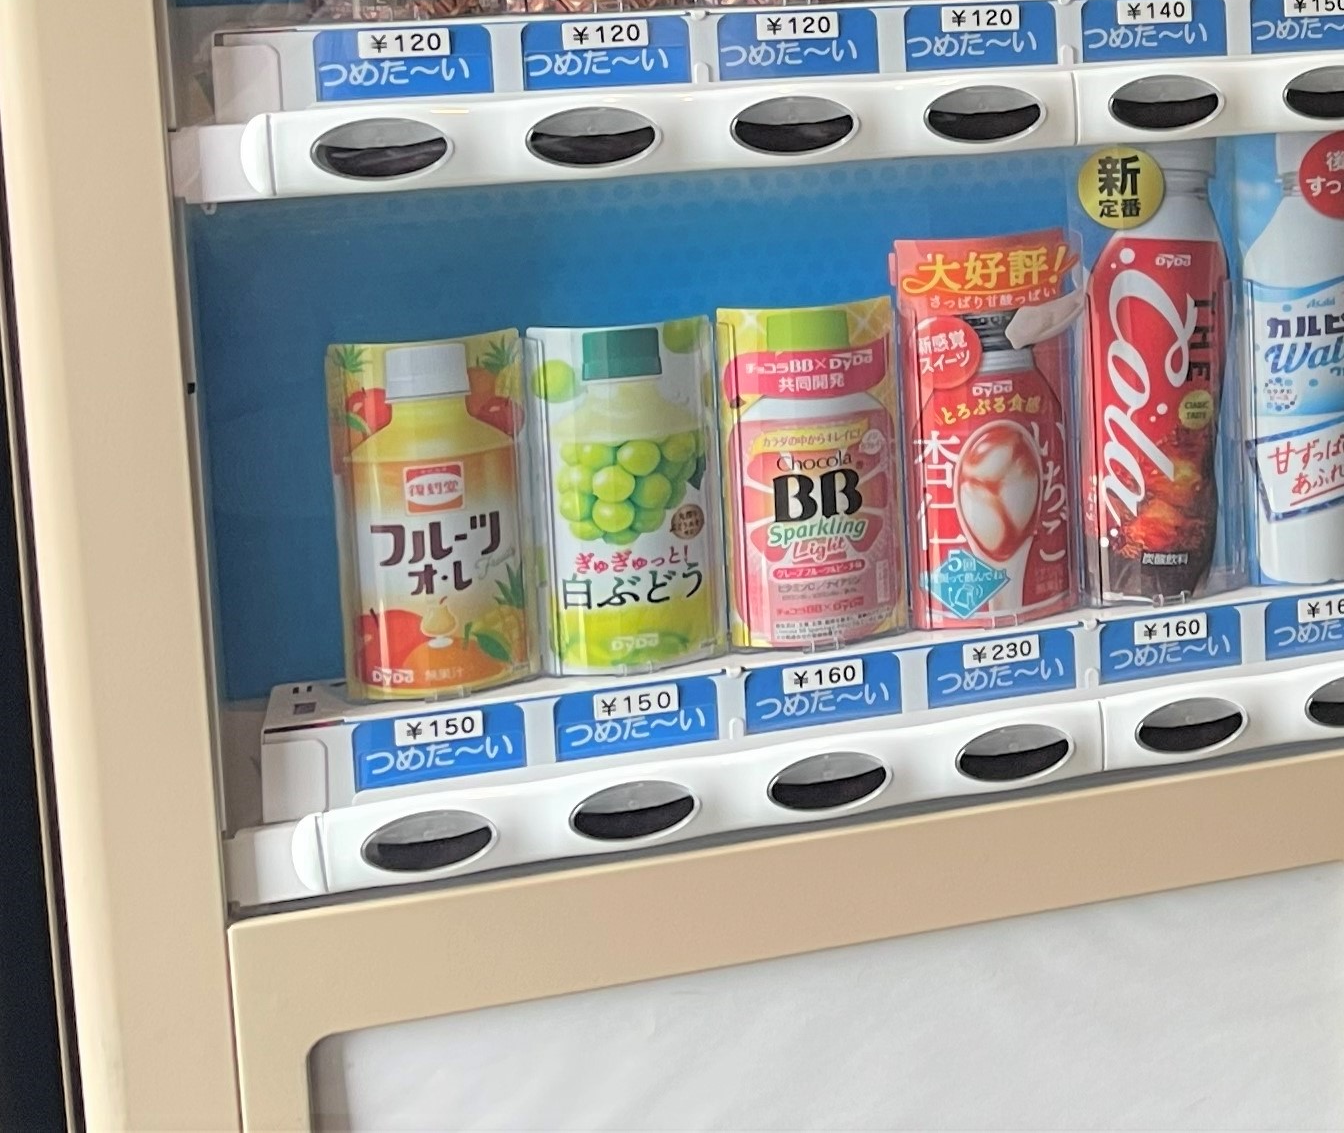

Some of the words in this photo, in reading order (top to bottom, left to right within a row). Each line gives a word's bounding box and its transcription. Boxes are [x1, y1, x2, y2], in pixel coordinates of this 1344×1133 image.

[951, 8, 1013, 27] ¥120
[1127, 0, 1186, 21] ¥140
[369, 32, 443, 54] ¥120
[573, 23, 643, 46] ¥120
[1097, 156, 1142, 198] 新
[1098, 197, 1142, 219] 定番
[917, 245, 1069, 291] 大好評!
[778, 372, 845, 393] 共同開発
[776, 450, 853, 472] Chocola
[772, 468, 863, 523] BB
[370, 510, 502, 567] フルーツ
[768, 517, 867, 545] Sparkling
[560, 568, 704, 611] 白ぶどう
[1143, 618, 1201, 640] ¥160
[971, 639, 1033, 662] ¥230
[793, 665, 857, 688] ¥160
[600, 689, 671, 716] ¥150
[405, 714, 476, 740] ¥150
